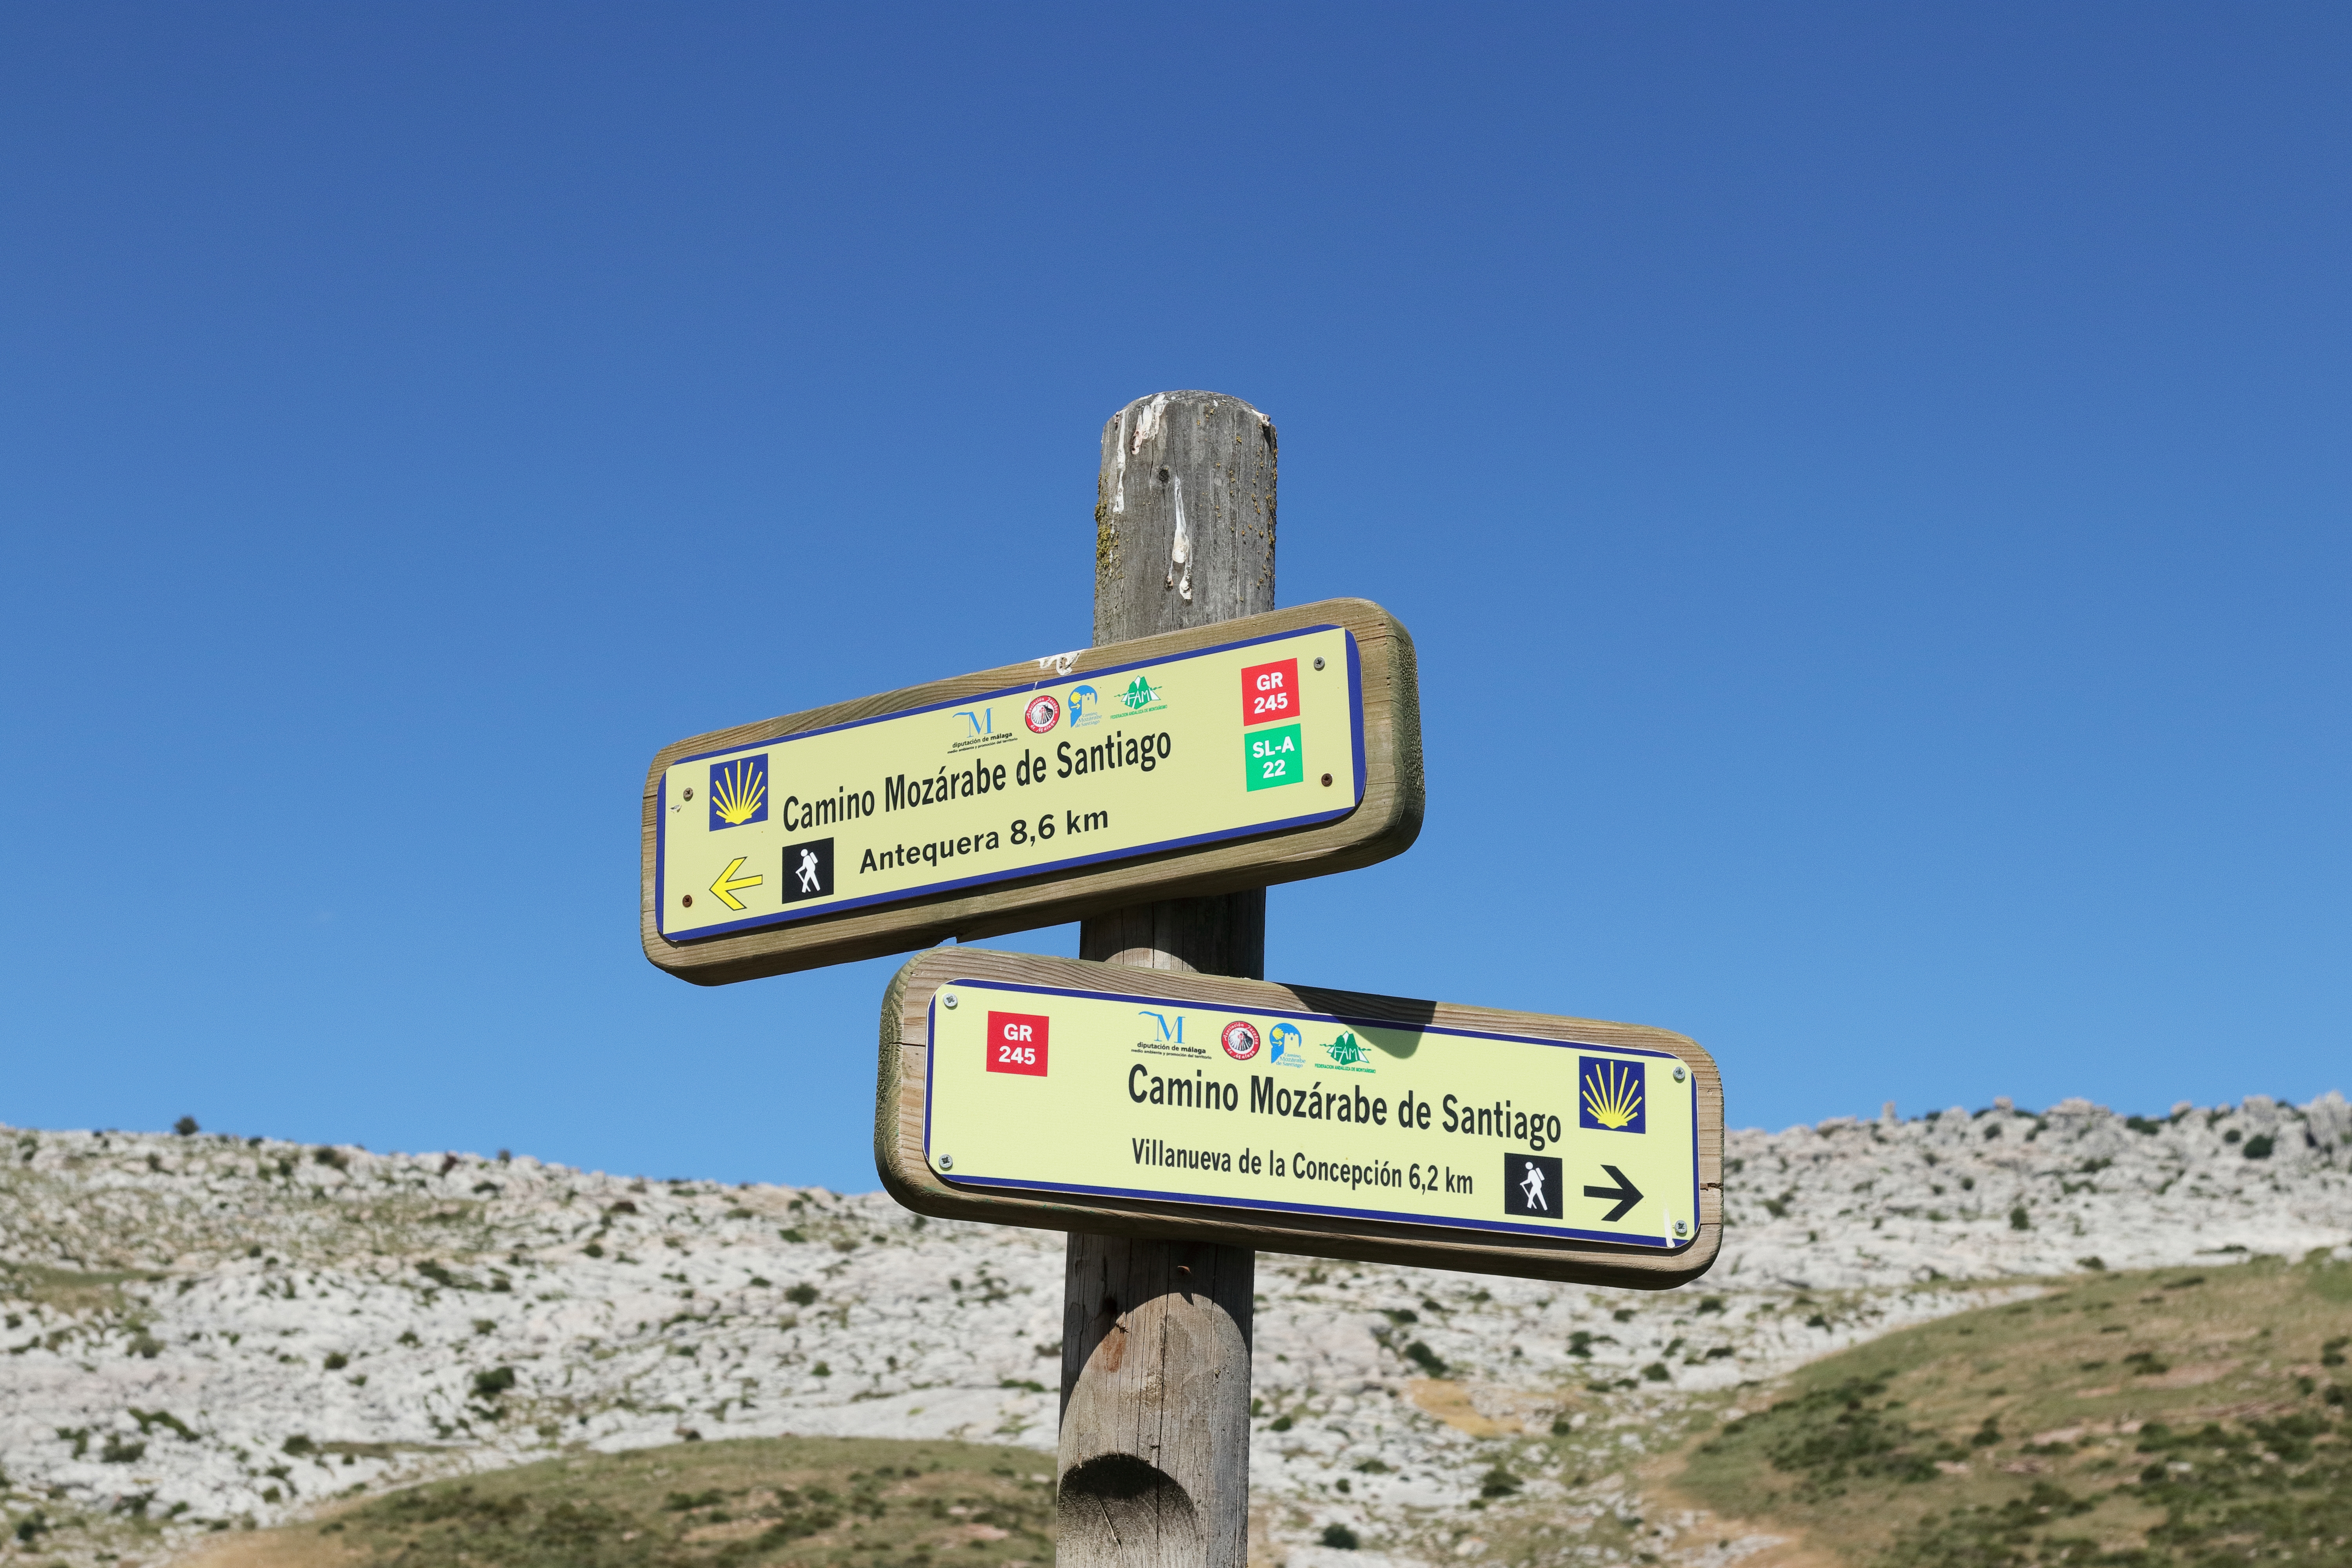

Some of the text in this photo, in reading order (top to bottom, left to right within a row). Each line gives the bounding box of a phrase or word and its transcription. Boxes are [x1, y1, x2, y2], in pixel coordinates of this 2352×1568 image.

[1256, 672, 1283, 691] GR
[1126, 690, 1150, 709] FAM
[1254, 692, 1288, 714] 245
[952, 739, 980, 748] diputación
[1252, 736, 1295, 758] SL-A
[1263, 759, 1286, 779] 22
[783, 731, 1171, 832] Camino Mozárabe de Santiago
[860, 810, 1108, 874] Antequera 8,6 km
[1004, 1024, 1033, 1042] GR
[998, 1045, 1036, 1065] 245
[1137, 1042, 1170, 1050] diputación
[1181, 1046, 1206, 1054] málaga
[1334, 1046, 1358, 1063] FAM
[1129, 1064, 1561, 1151] Camino Mozárabe de Santiago
[1132, 1138, 1472, 1195] Villanueva de la Concepción 6,2 km
